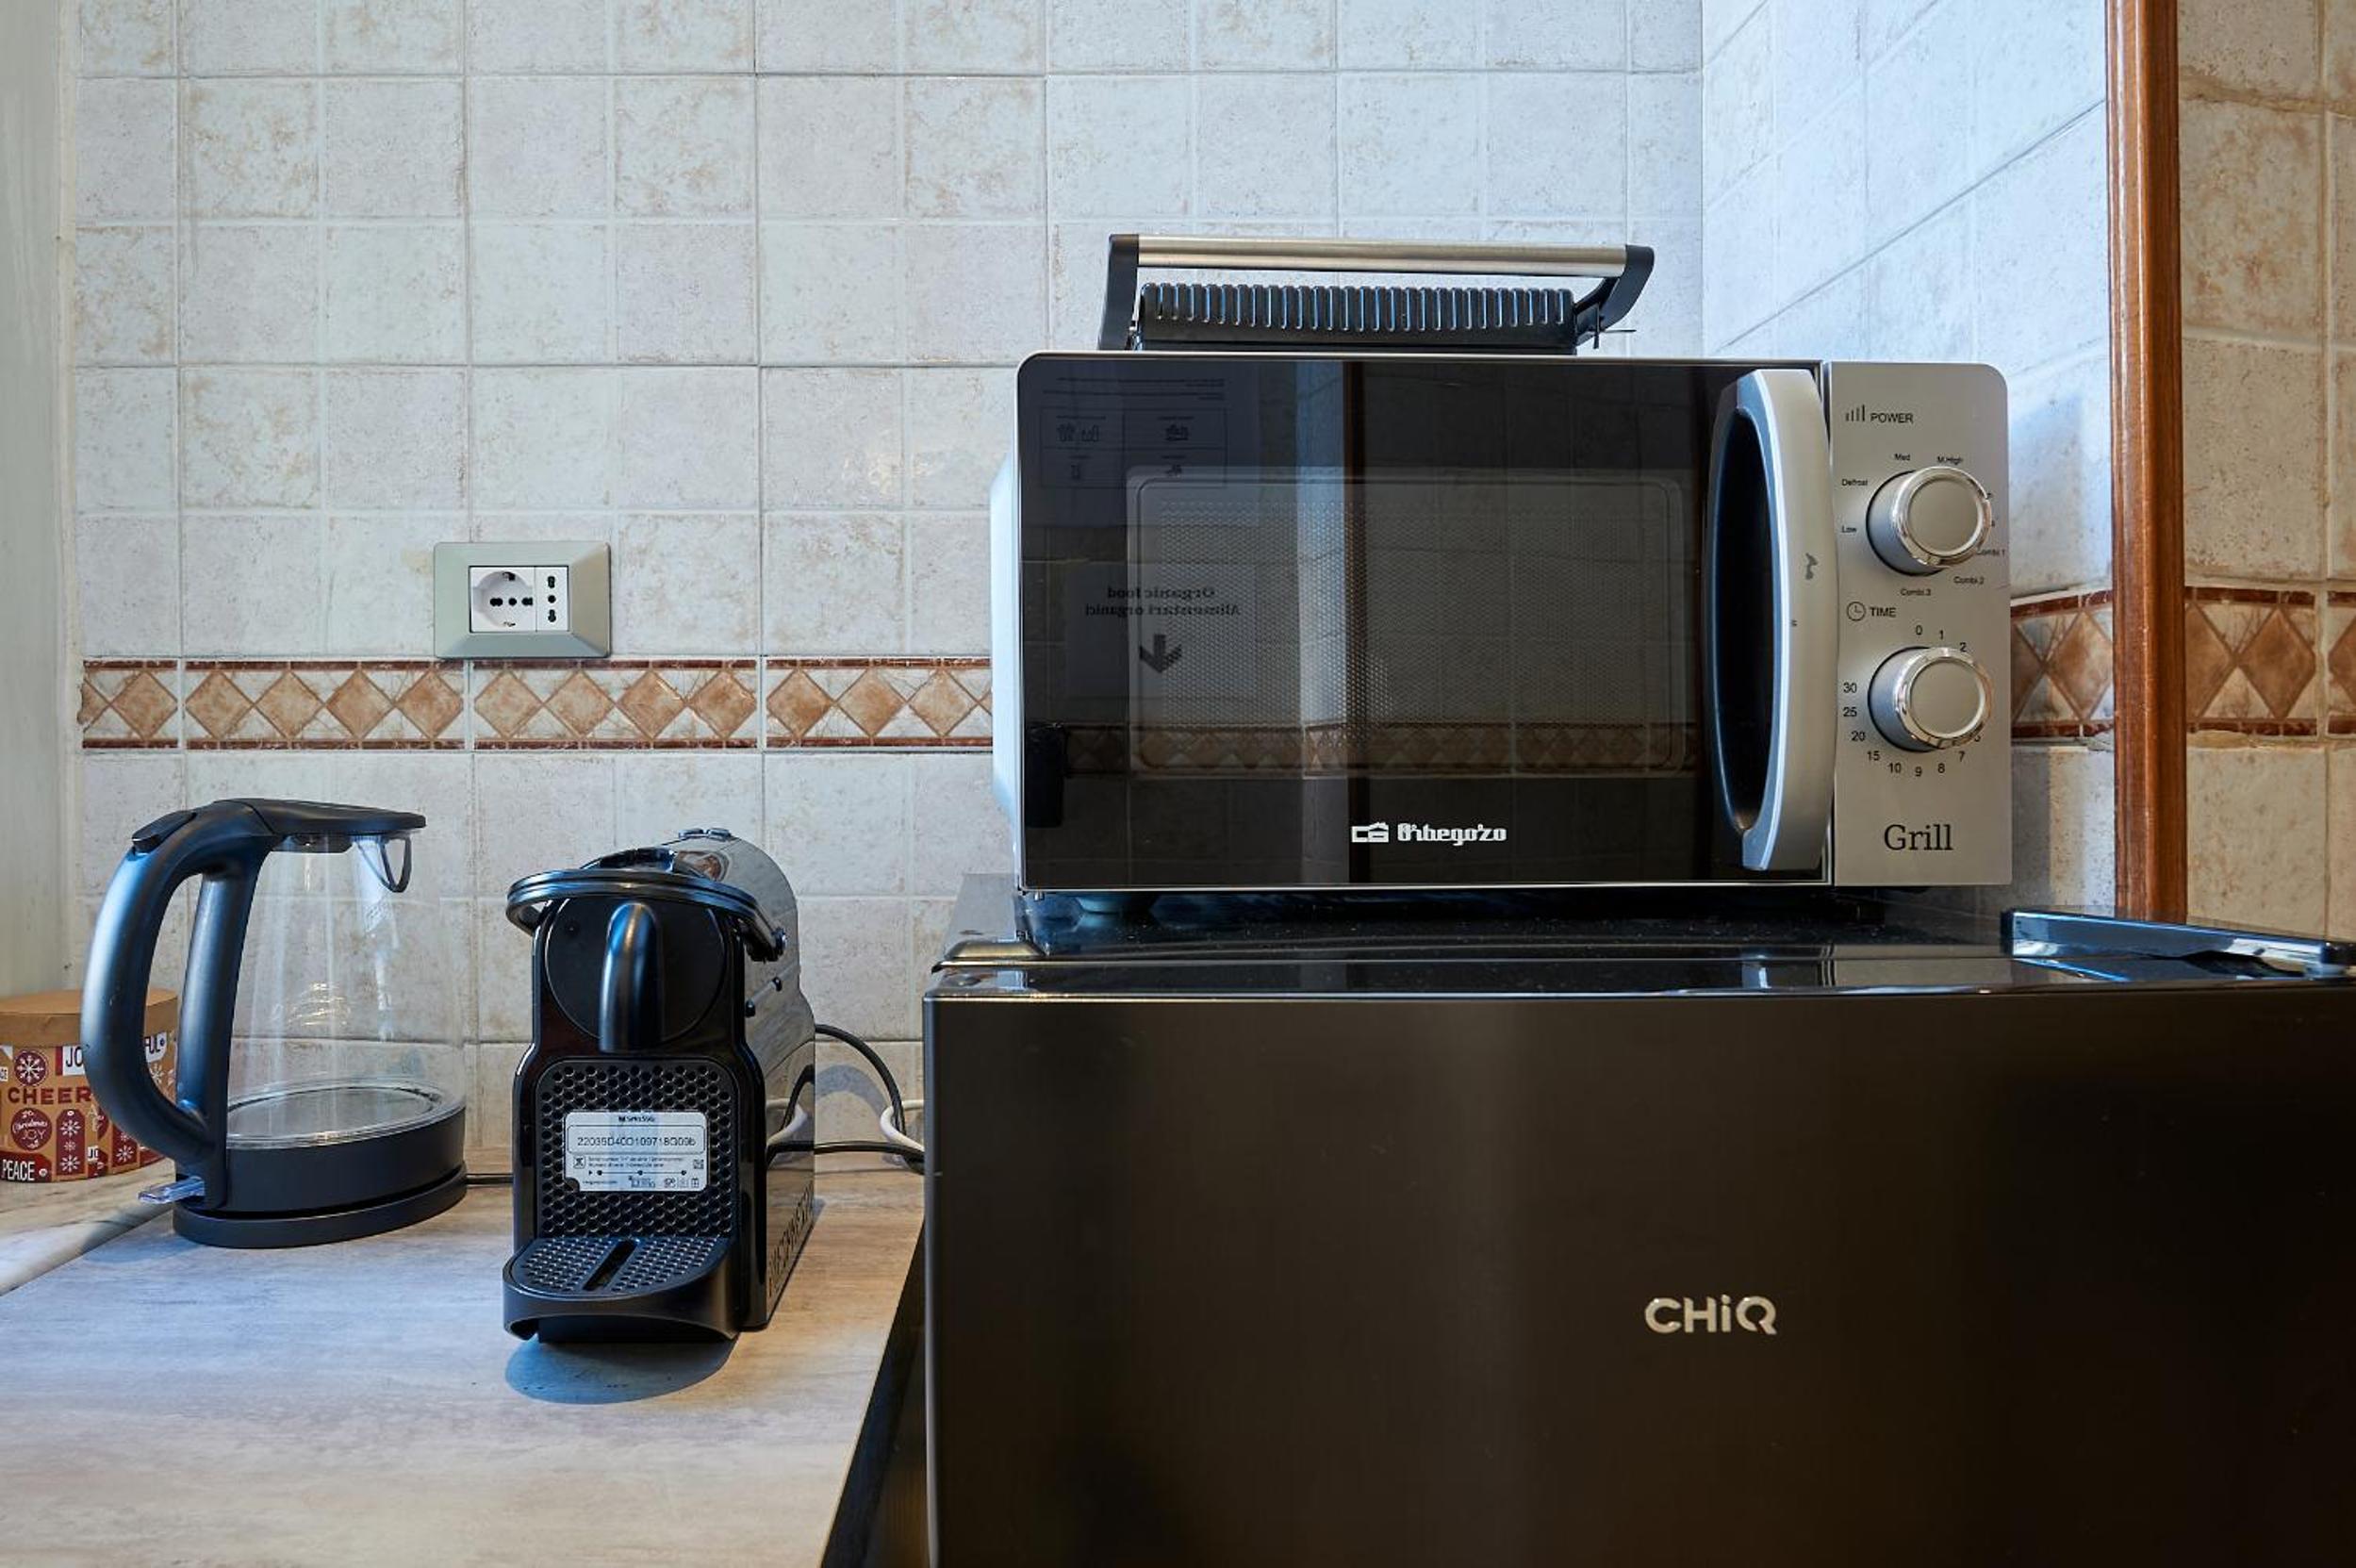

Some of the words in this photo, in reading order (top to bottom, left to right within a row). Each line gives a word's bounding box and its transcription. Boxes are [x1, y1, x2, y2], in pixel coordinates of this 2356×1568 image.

[1870, 413, 1914, 423] POWER
[1870, 607, 1896, 617] TIME
[1916, 626, 1923, 635] 0
[1938, 631, 1944, 640] 1
[1960, 642, 1967, 652] 2
[1843, 683, 1857, 693] 30
[1843, 707, 1857, 717] 25
[1852, 732, 1866, 741] 20
[1868, 751, 1880, 761] 15
[1959, 751, 1965, 762] 7
[1888, 763, 1902, 773] 10
[1915, 767, 1922, 777] 9
[1937, 763, 1945, 773] 8
[1885, 825, 1953, 850] Grill
[2, 1159, 35, 1180] PEACE
